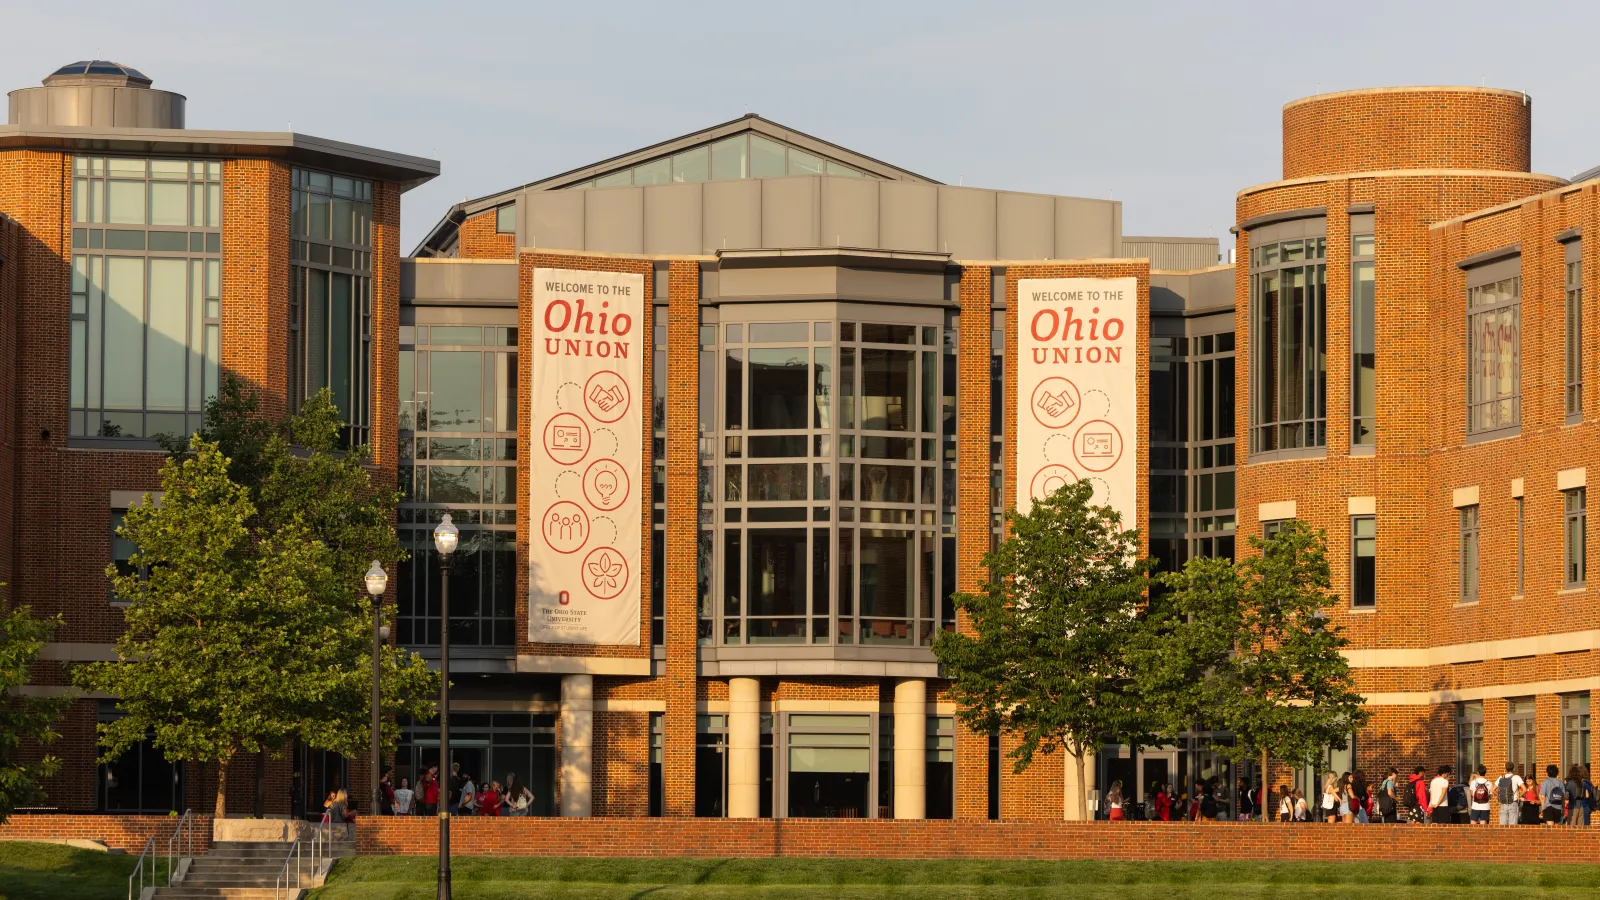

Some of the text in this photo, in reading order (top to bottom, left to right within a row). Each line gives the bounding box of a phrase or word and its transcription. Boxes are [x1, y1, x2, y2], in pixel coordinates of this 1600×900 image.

[545, 281, 631, 297] WELCOME TO THE
[1032, 290, 1124, 302] WELCOME TO THE
[543, 298, 632, 337] Ohio
[1030, 306, 1125, 342] Ohio
[544, 337, 630, 360] UNION
[1031, 346, 1123, 365] UNION
